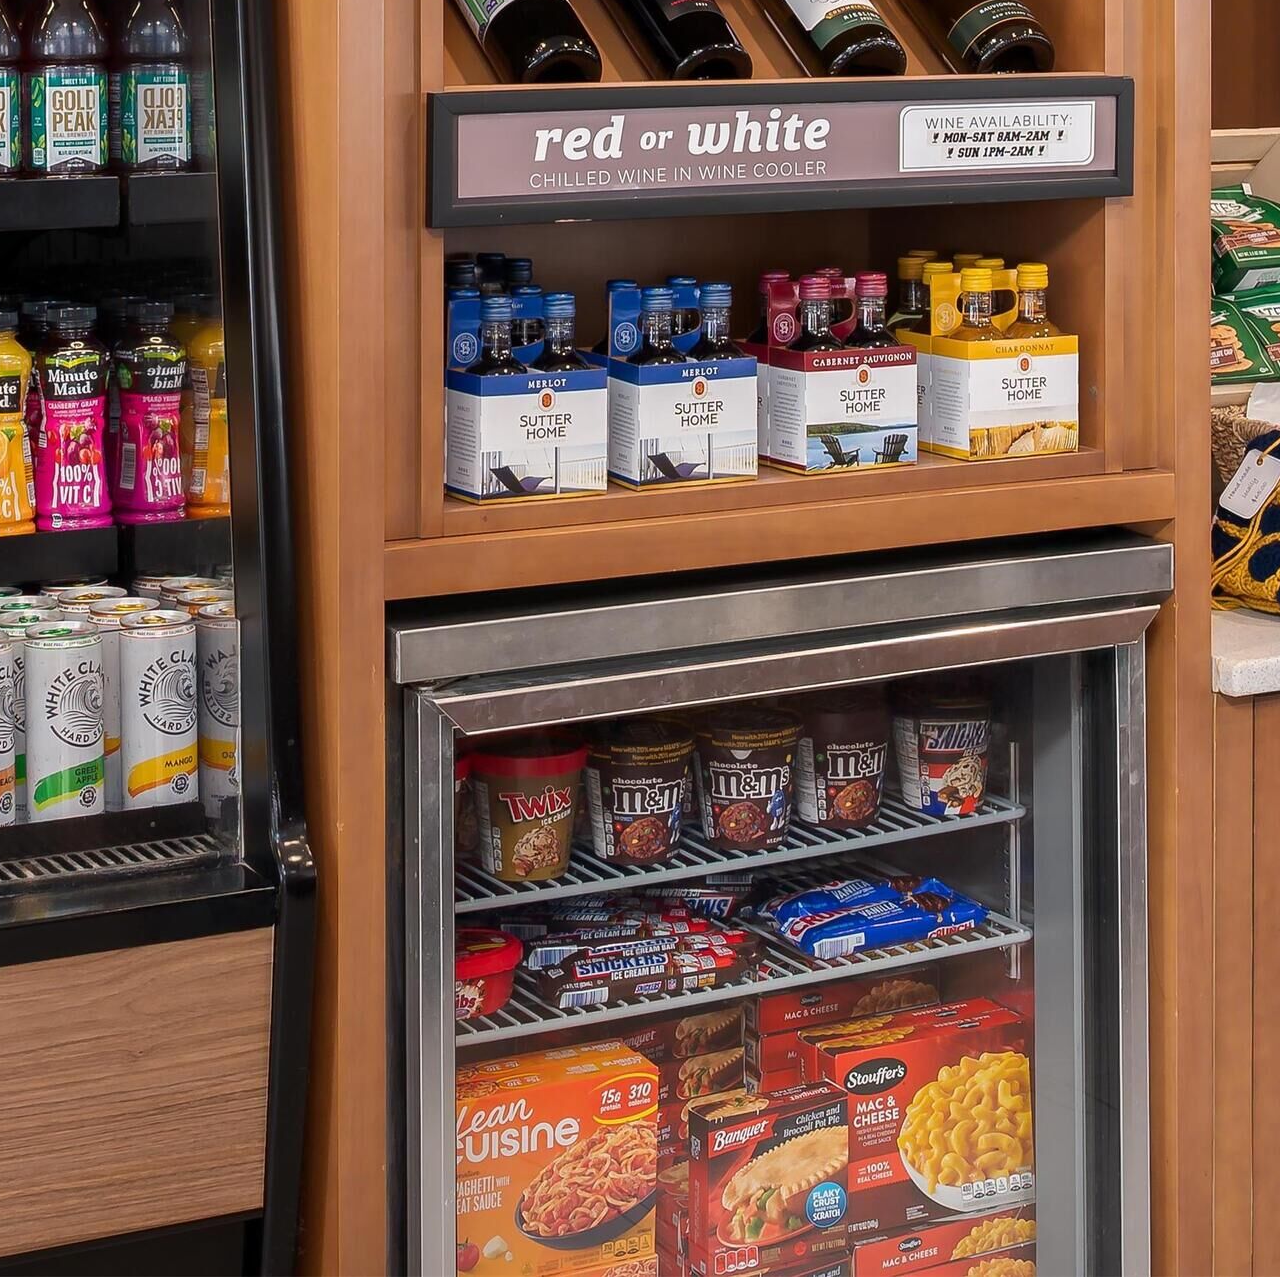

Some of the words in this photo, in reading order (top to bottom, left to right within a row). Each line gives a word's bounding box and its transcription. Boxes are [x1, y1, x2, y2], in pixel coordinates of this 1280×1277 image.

[52, 90, 97, 112] GOLD
[52, 113, 97, 132] PEAK
[925, 116, 965, 130] WINE
[969, 114, 1073, 128] AVAILABILITY:
[534, 114, 625, 162] red
[639, 127, 674, 151] or
[687, 107, 831, 156] white
[943, 132, 995, 144] MON-SAT
[997, 130, 1051, 142] 8AM-2AM
[957, 147, 980, 158] SUN
[983, 146, 1035, 157] 1PM-2AM
[529, 170, 611, 189] CHILLED
[618, 167, 667, 185] WINE
[674, 166, 692, 181] IN
[698, 164, 747, 179] WINE
[753, 161, 827, 177] COOLER
[813, 356, 861, 367] CABERNET
[863, 352, 913, 364] SAUVIGNON
[682, 367, 718, 377] MERLOT
[528, 378, 567, 389] MERLOT
[1001, 377, 1047, 390] SUTTER
[839, 388, 886, 402] SUTTER
[1007, 389, 1042, 401] HOME
[674, 400, 723, 415] SUTTER
[845, 400, 881, 414] HOME
[520, 414, 573, 427] SUTTER
[681, 413, 719, 427] HOME
[526, 426, 567, 440] HOME
[59, 464, 93, 483] 100%
[153, 715, 182, 731] HARD
[60, 727, 90, 743] HARD
[165, 756, 193, 768] MANGO
[612, 777, 663, 785] chocolate
[500, 785, 571, 823] Twix
[578, 953, 668, 976] SNICKERS
[846, 1064, 905, 1088] Stouffer's
[600, 1103, 621, 1115] protein
[628, 1097, 651, 1107] calories
[856, 1099, 884, 1114] MAC
[885, 1097, 896, 1109] &
[853, 1109, 900, 1128] CHEESE
[712, 1121, 768, 1152] Banquet
[812, 1190, 840, 1201] FLAKY
[813, 1196, 840, 1207] CRUST
[812, 1208, 841, 1221] SCRATCH
